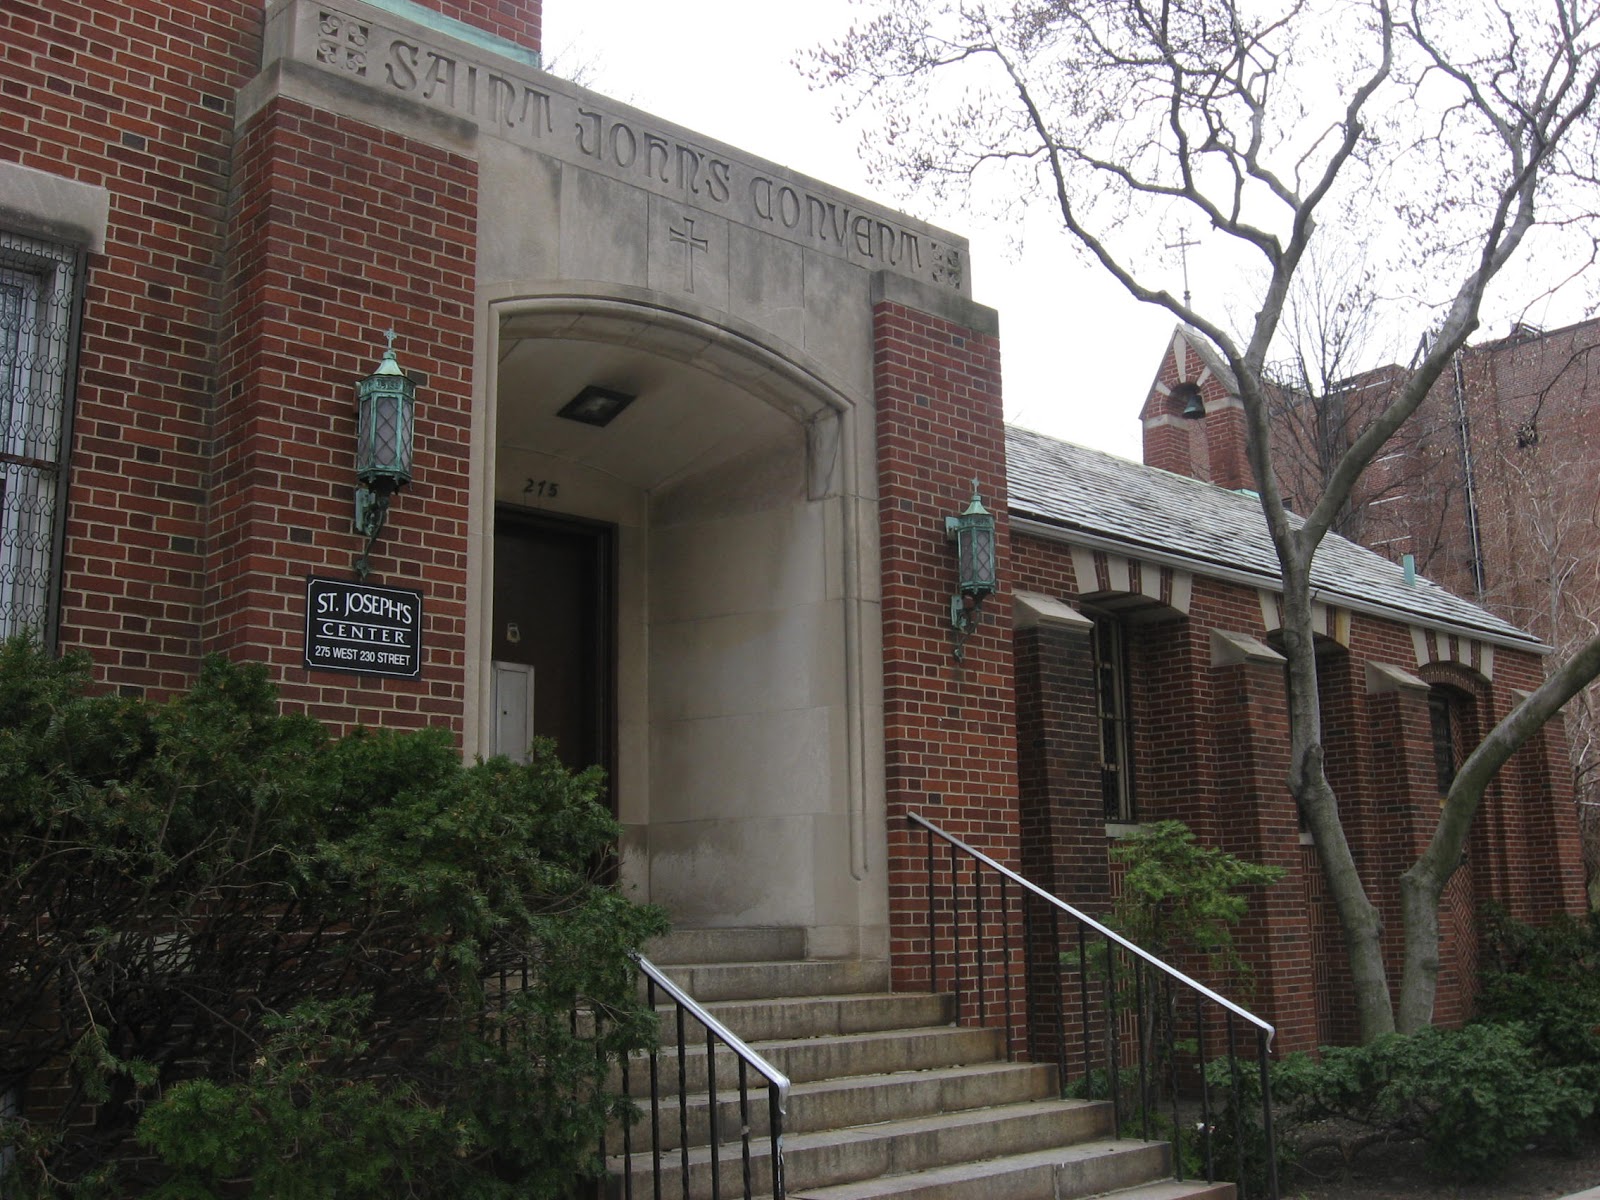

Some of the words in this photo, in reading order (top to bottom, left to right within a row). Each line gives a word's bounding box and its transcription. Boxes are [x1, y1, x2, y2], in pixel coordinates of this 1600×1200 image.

[384, 39, 553, 138] SAINT
[750, 176, 922, 268] CONVENT
[317, 592, 339, 613] ST.
[344, 592, 412, 624] JOSEPH'S
[322, 622, 405, 644] CENTER
[315, 645, 331, 658] 275
[332, 647, 358, 660] WEST
[359, 650, 376, 663] 230
[377, 652, 411, 666] STREET
